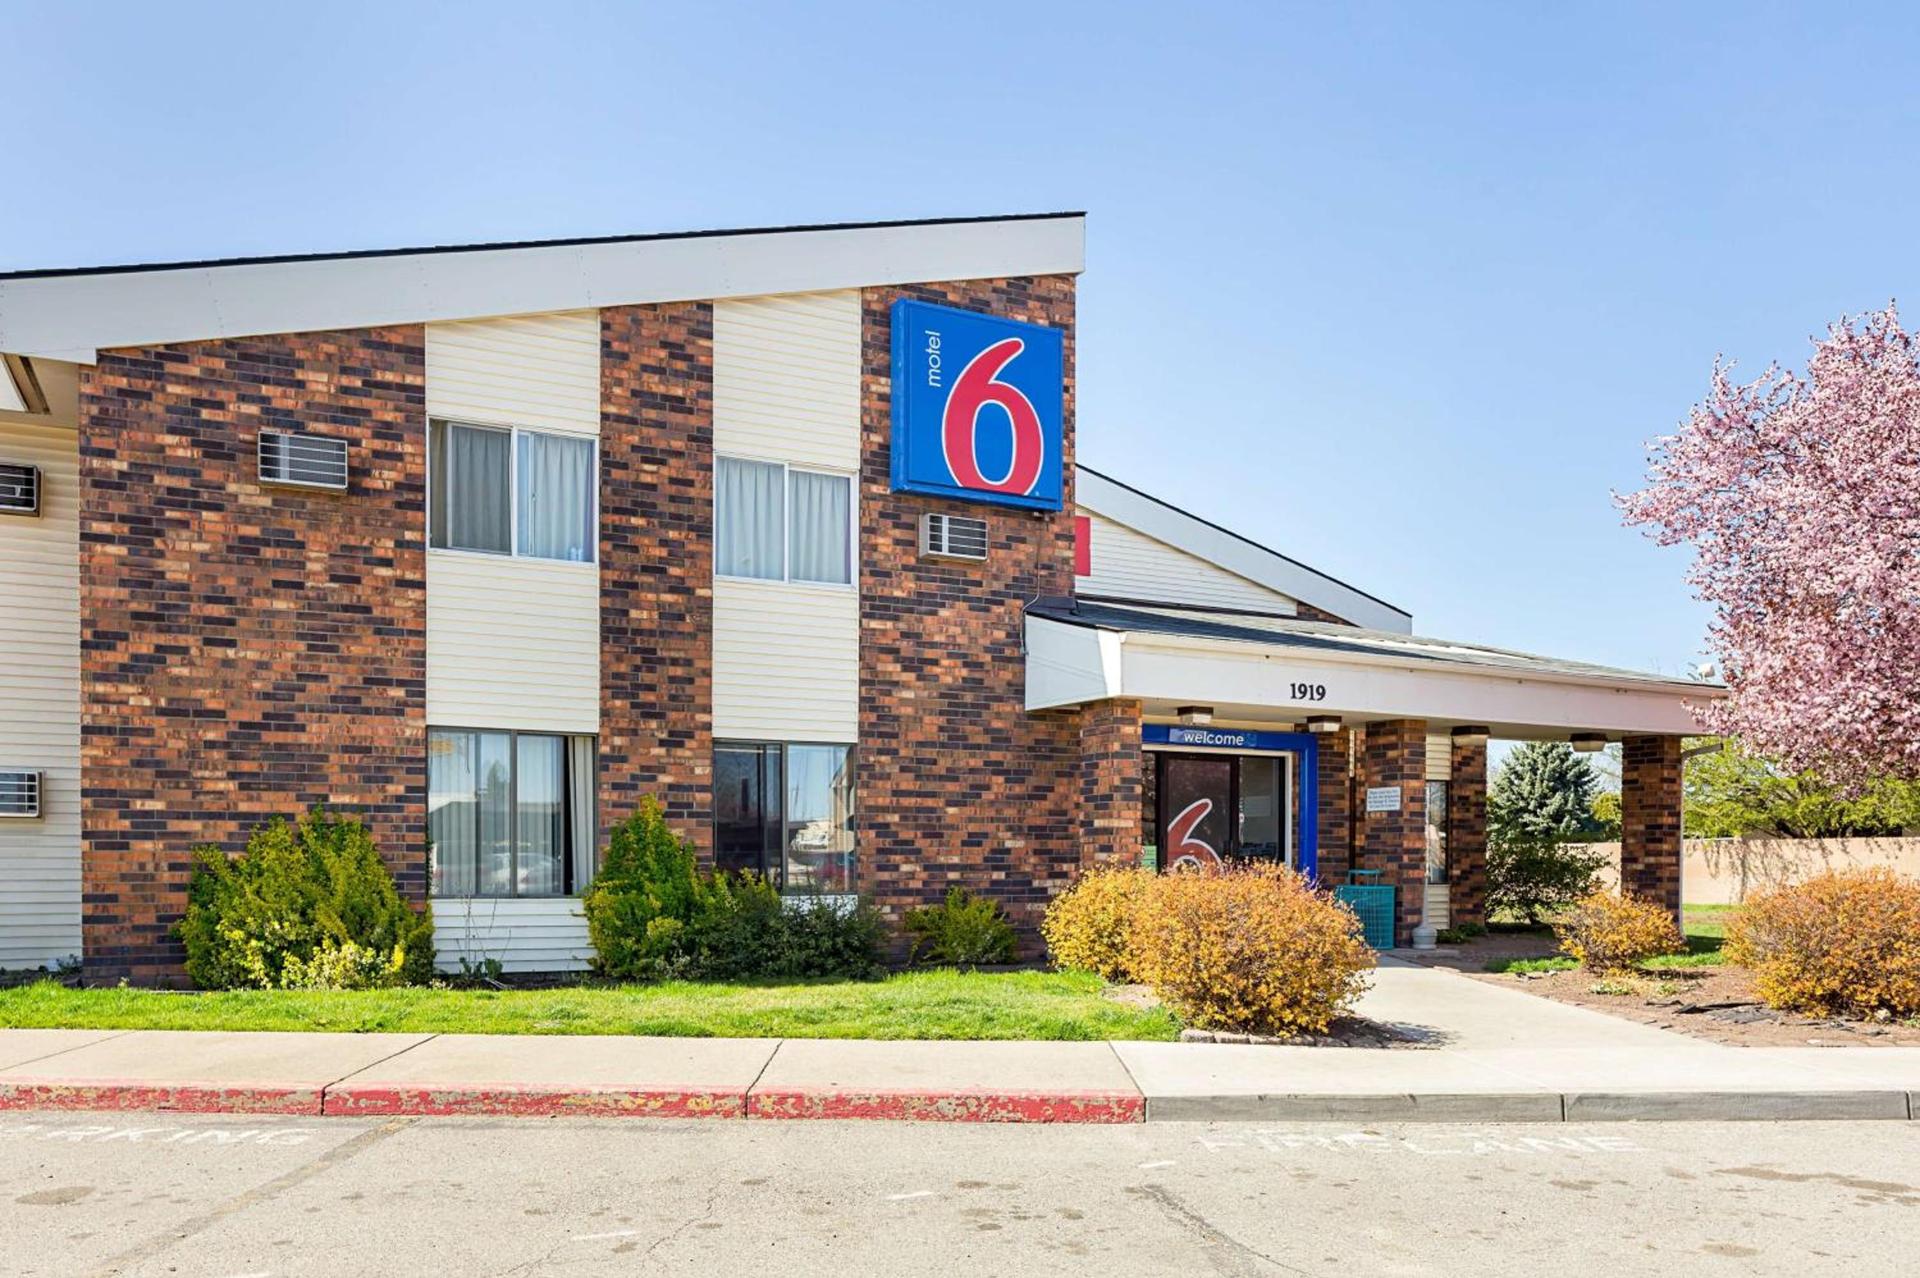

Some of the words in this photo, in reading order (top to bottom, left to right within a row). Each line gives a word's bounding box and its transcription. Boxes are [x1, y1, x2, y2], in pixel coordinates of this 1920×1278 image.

[925, 330, 941, 388] motel
[942, 337, 1044, 496] 6
[1290, 683, 1326, 701] 1919
[1184, 731, 1244, 746] welcome
